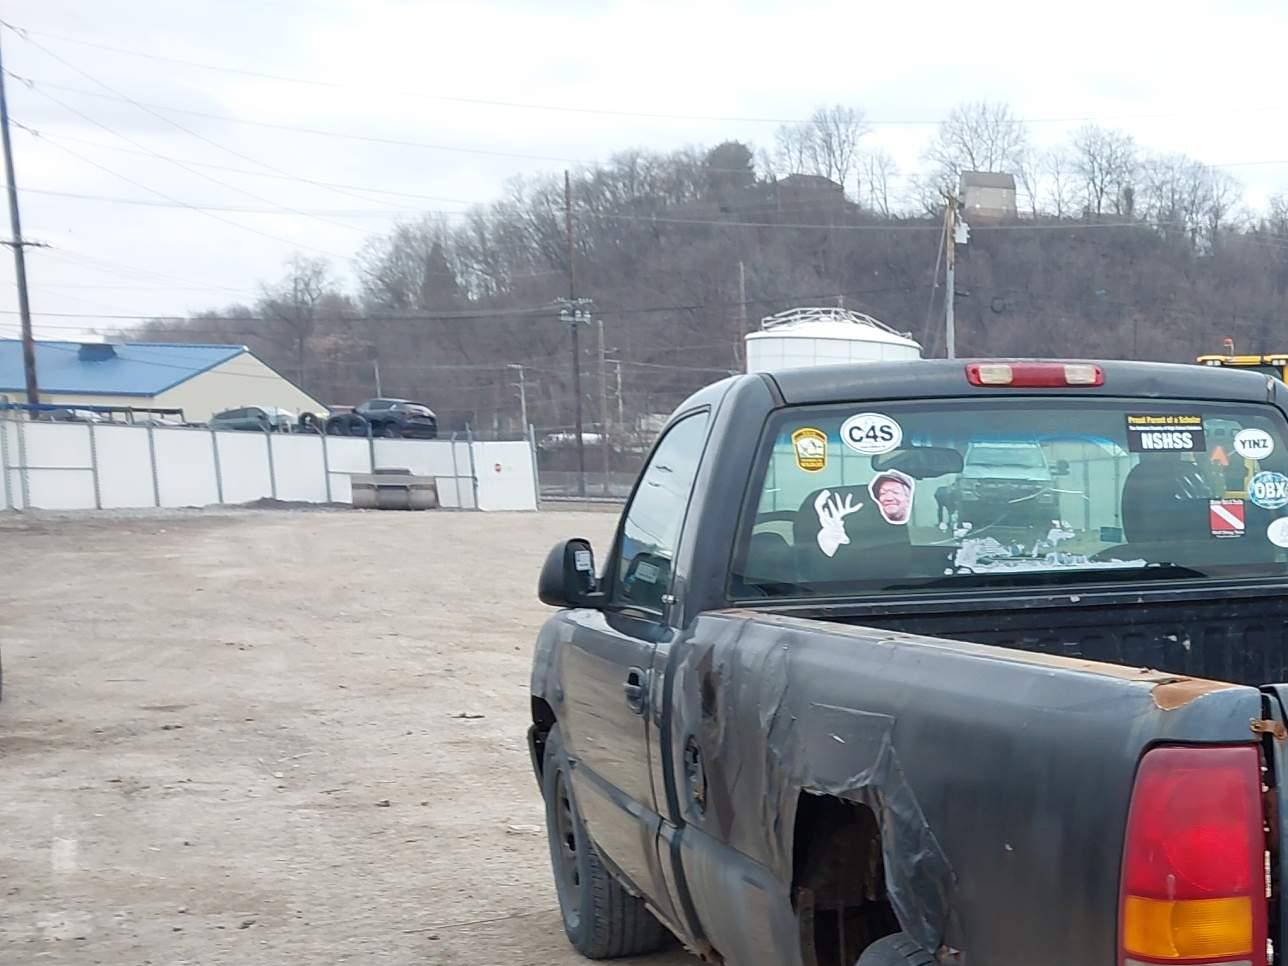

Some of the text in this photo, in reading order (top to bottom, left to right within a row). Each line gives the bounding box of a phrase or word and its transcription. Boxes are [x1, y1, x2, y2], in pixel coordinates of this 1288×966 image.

[849, 425, 894, 442] C4S
[1141, 432, 1193, 449] NSHSS
[1240, 438, 1269, 449] YINZ
[1255, 482, 1287, 499] OBX
